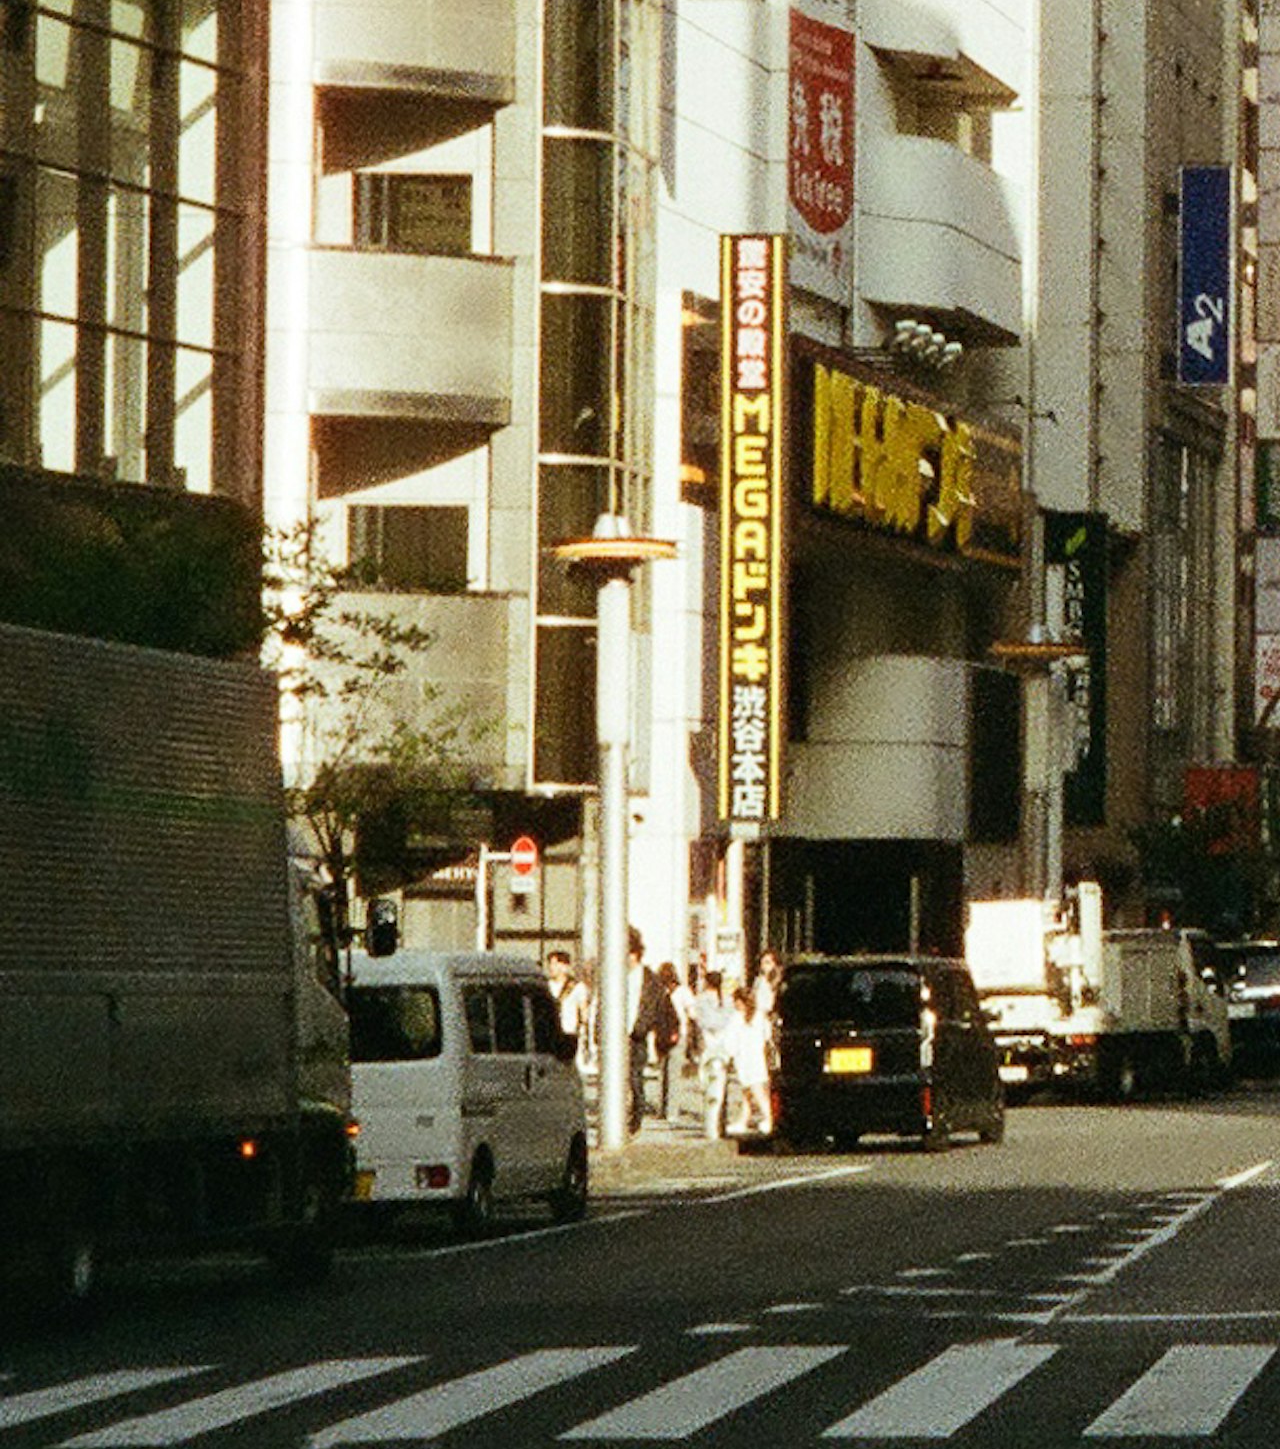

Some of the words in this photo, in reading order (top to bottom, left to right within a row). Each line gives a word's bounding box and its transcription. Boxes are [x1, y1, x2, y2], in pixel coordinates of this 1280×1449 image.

[1186, 292, 1224, 363] A2
[731, 393, 770, 682] MEGAドンキ
[731, 685, 766, 819] 渋谷本店
